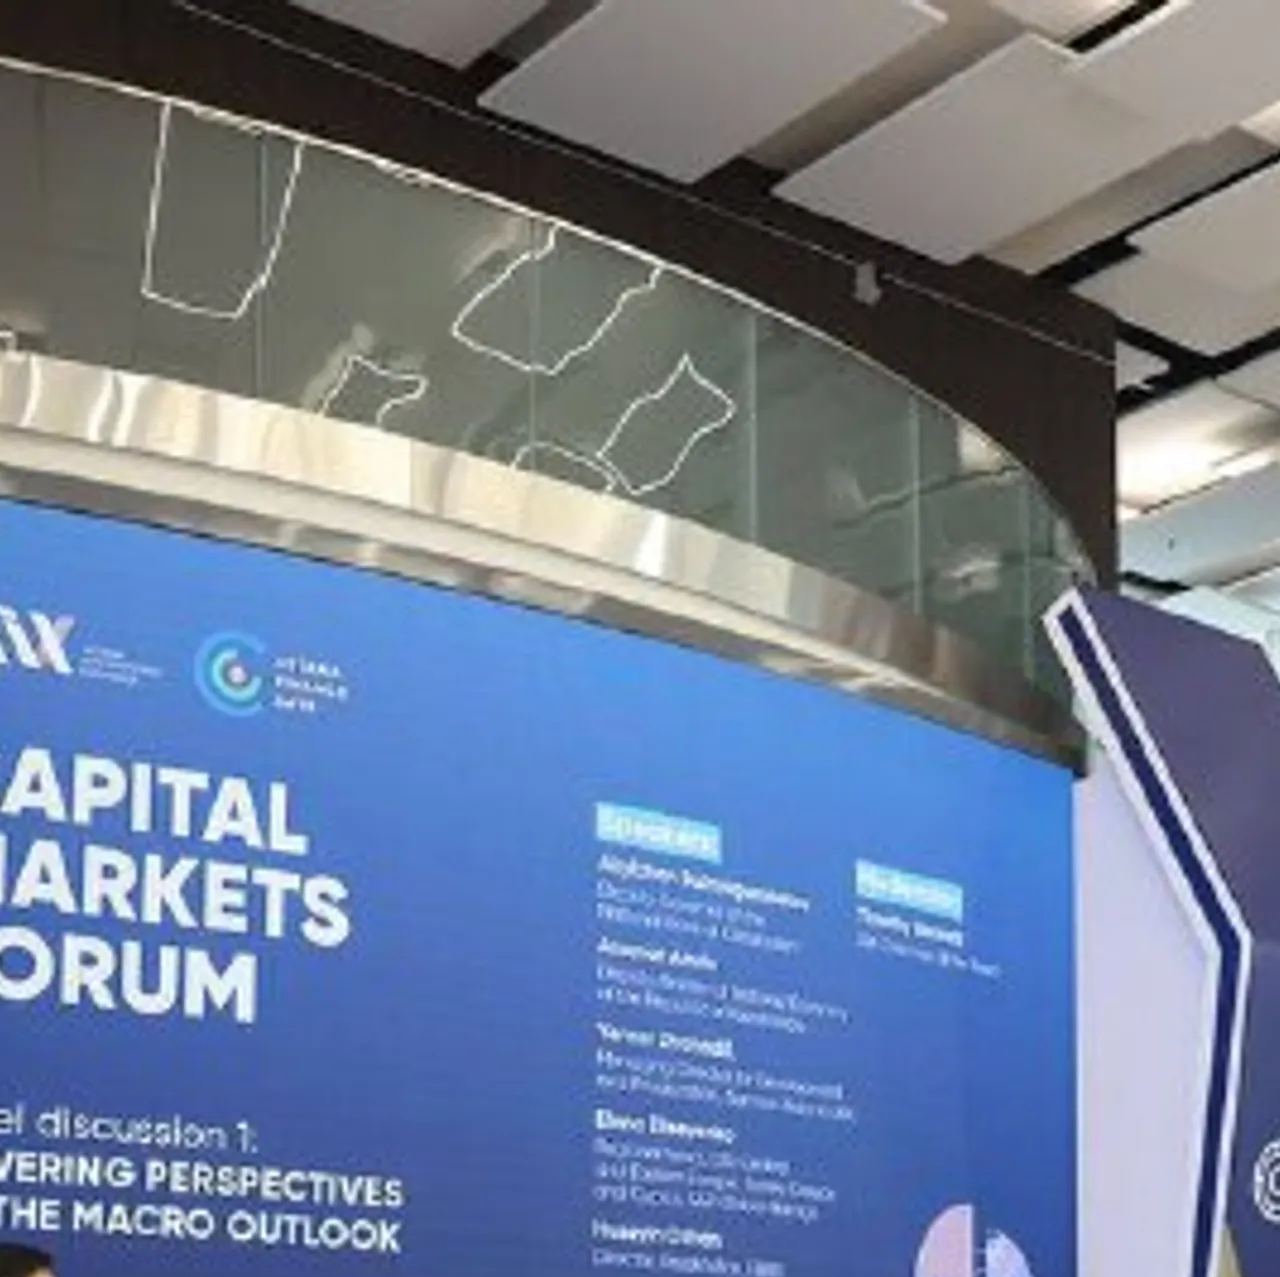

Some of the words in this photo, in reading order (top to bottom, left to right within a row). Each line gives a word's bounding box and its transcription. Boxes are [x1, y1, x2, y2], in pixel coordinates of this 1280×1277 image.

[35, 1106, 229, 1150] discussion
[144, 1158, 405, 1209] PERSPECTIVES
[72, 1200, 216, 1241] MACRO
[226, 1208, 403, 1255] OUTLOOK
